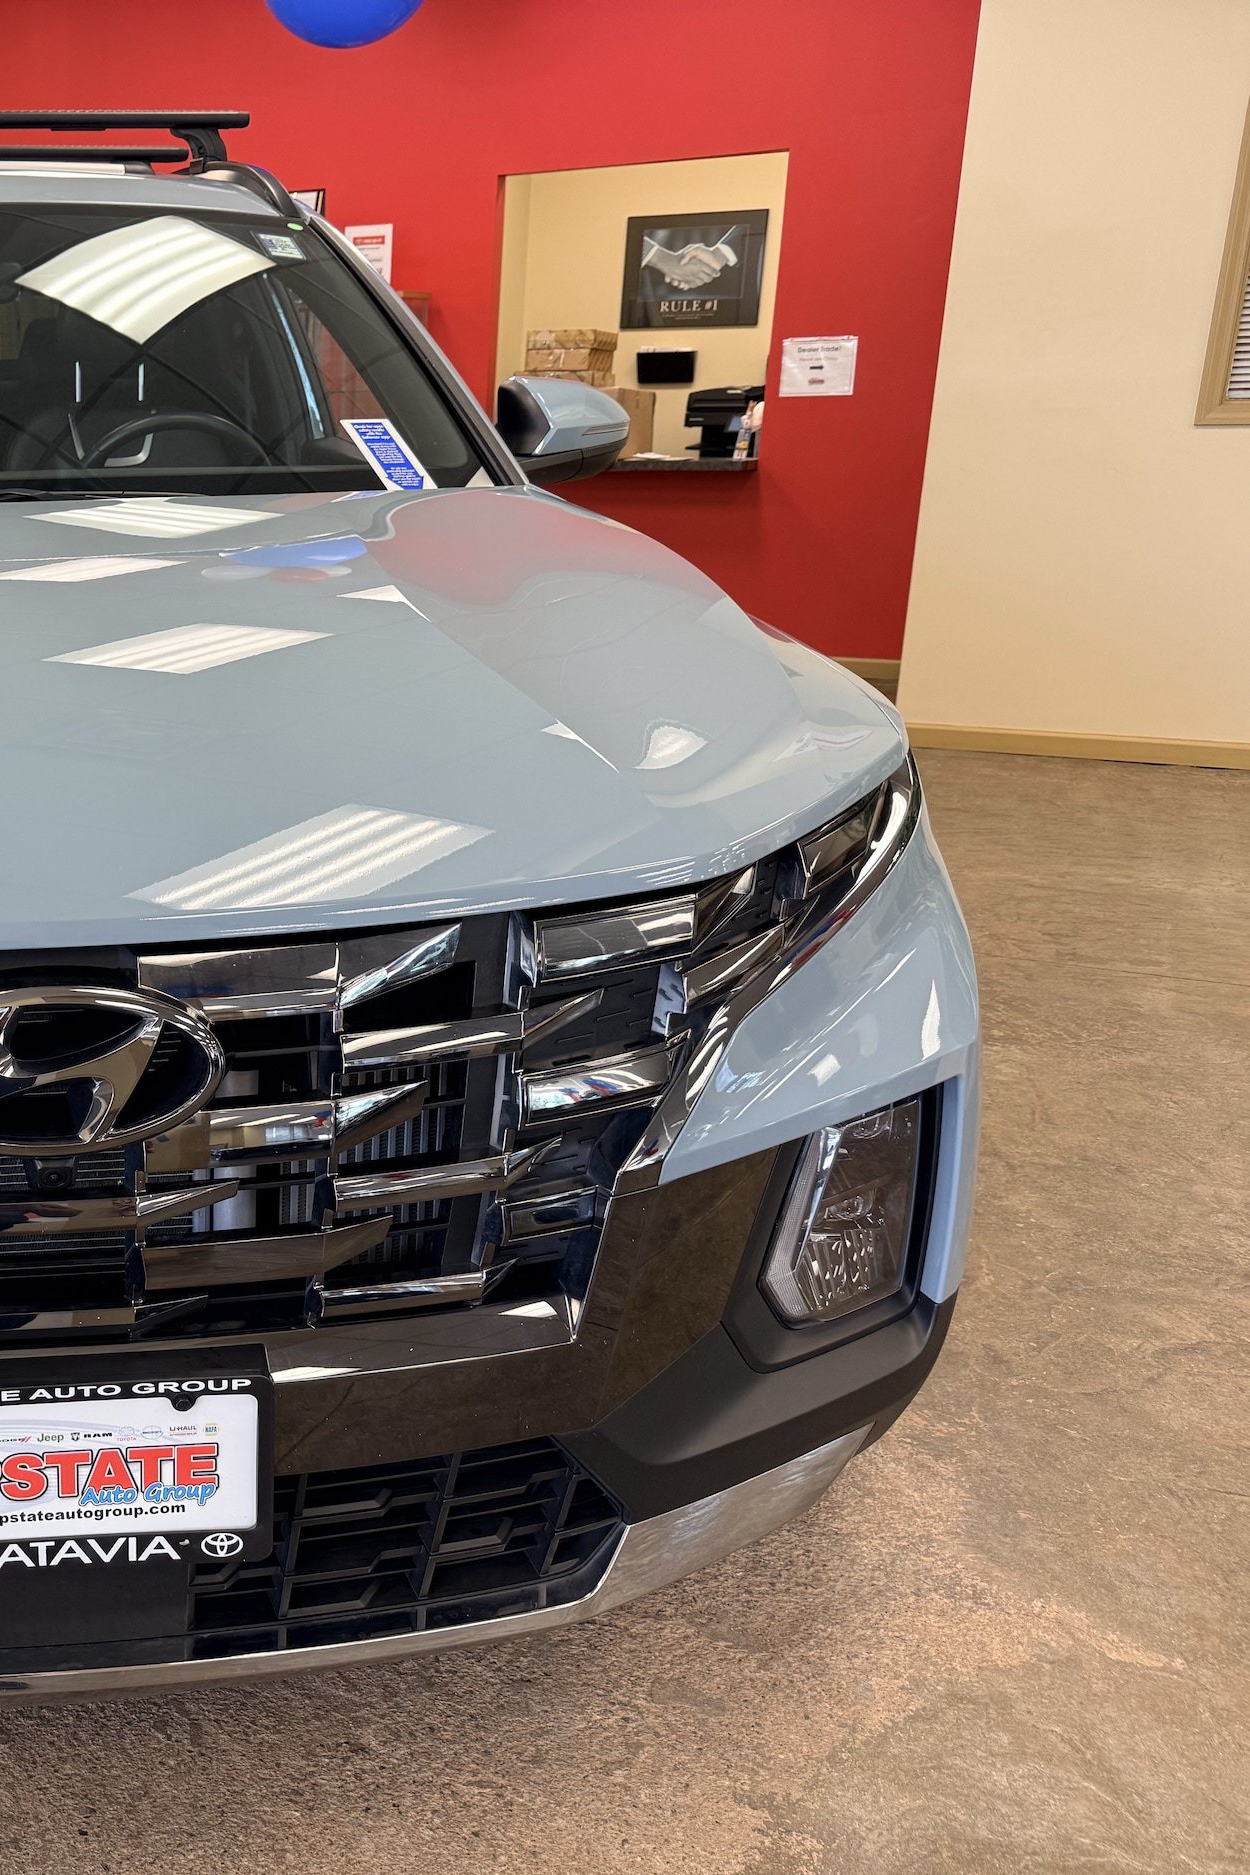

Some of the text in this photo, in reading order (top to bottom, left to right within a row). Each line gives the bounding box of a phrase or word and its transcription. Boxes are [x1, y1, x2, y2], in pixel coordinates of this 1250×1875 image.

[659, 300, 701, 313] RULE
[29, 1384, 122, 1400] AUTO
[131, 1379, 252, 1394] GROUP
[37, 1432, 64, 1444] Jeep
[78, 1482, 218, 1506] Auto Group
